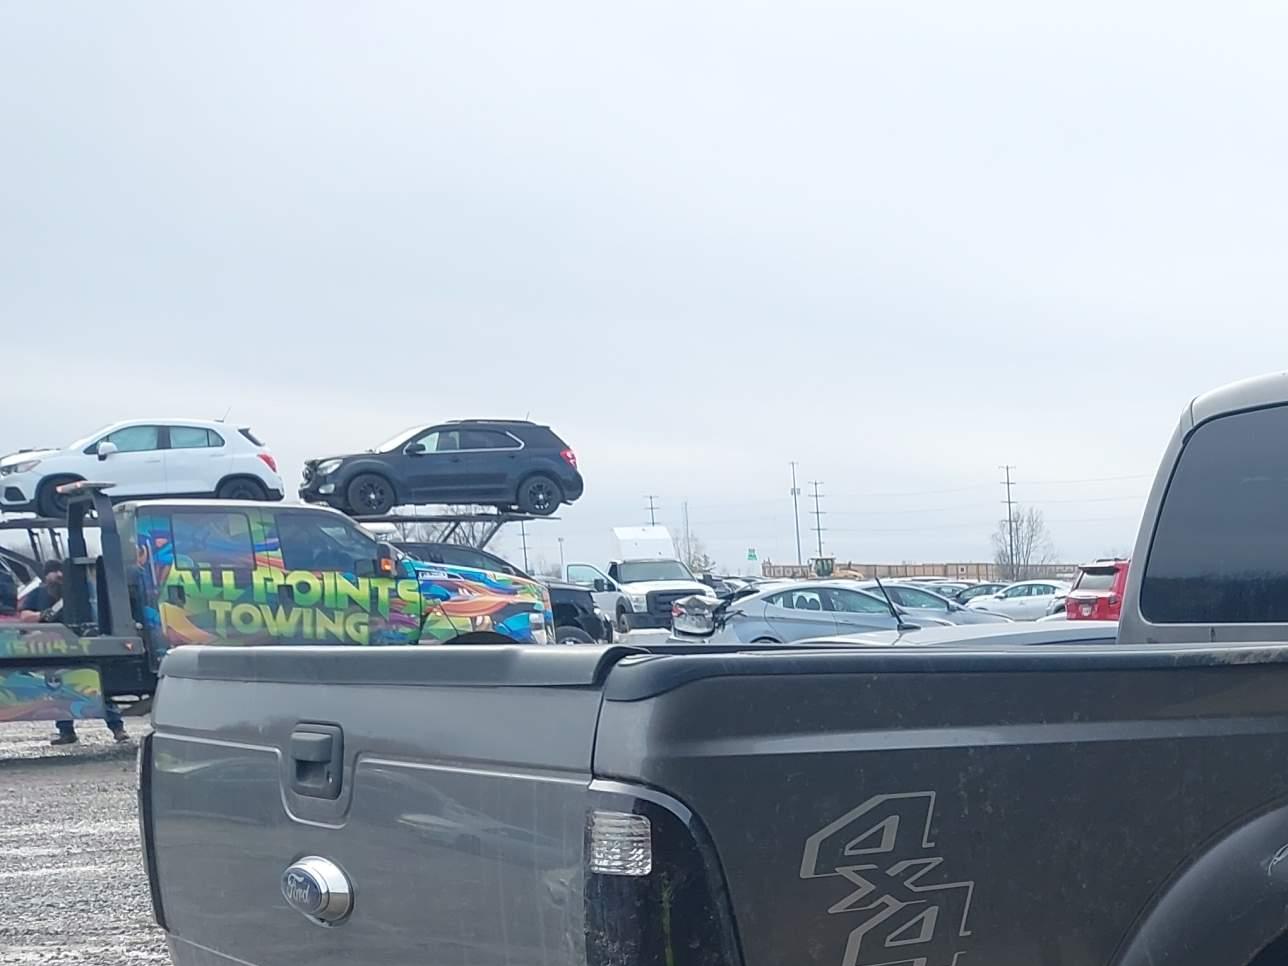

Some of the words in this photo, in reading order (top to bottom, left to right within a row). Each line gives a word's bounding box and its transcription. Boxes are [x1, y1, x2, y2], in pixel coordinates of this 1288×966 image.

[158, 562, 247, 610] ALL
[252, 566, 421, 620] POINTS
[208, 600, 370, 645] TOWING
[286, 873, 310, 904] Ford
